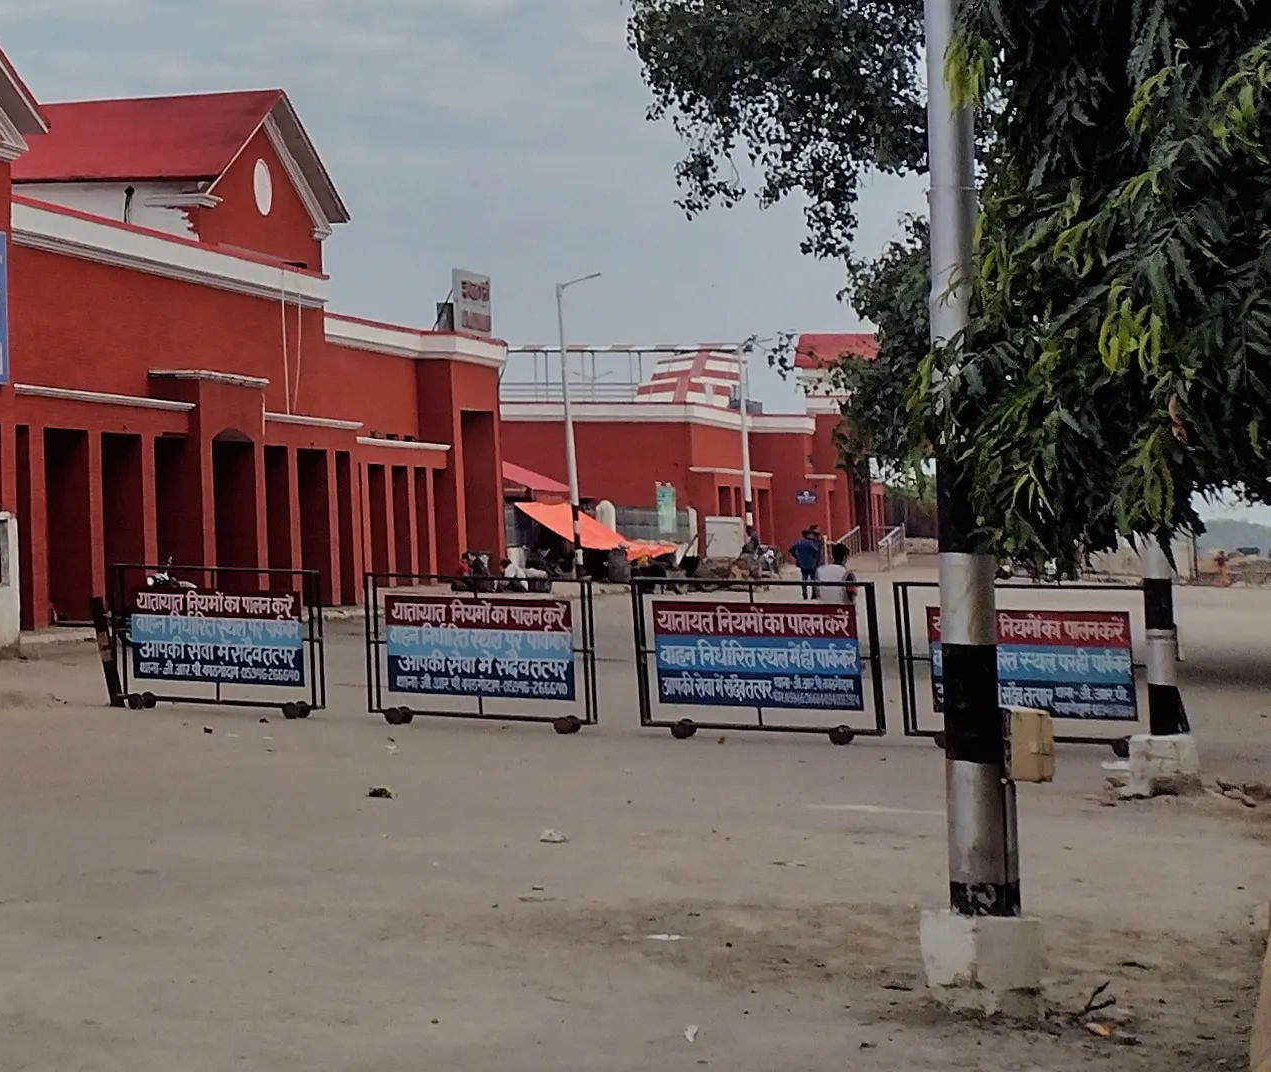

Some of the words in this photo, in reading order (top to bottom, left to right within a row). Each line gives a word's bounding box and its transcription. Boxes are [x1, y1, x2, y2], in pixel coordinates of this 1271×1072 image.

[137, 592, 184, 611] यातायात
[186, 590, 224, 612] नियमों
[224, 596, 240, 613] का
[242, 596, 270, 614] पालन
[272, 593, 294, 617] करें
[391, 602, 447, 623] यातायात
[450, 599, 491, 623] नियमों
[492, 605, 508, 624] का
[510, 606, 543, 627] पालन
[543, 602, 567, 630] करें
[716, 605, 763, 633] नियमों
[764, 613, 785, 634] का
[998, 612, 1041, 638] नियमों
[139, 636, 184, 659] आपकी
[187, 637, 214, 661] सेवा
[398, 648, 445, 673] आपकी
[446, 651, 475, 675] सेवा
[660, 645, 696, 666] वाहन
[697, 639, 756, 668] निर्धारित
[757, 647, 789, 668] स्थल
[1019, 652, 1057, 674] स्थल
[661, 671, 694, 696] आपकी
[694, 672, 714, 697] सेवा
